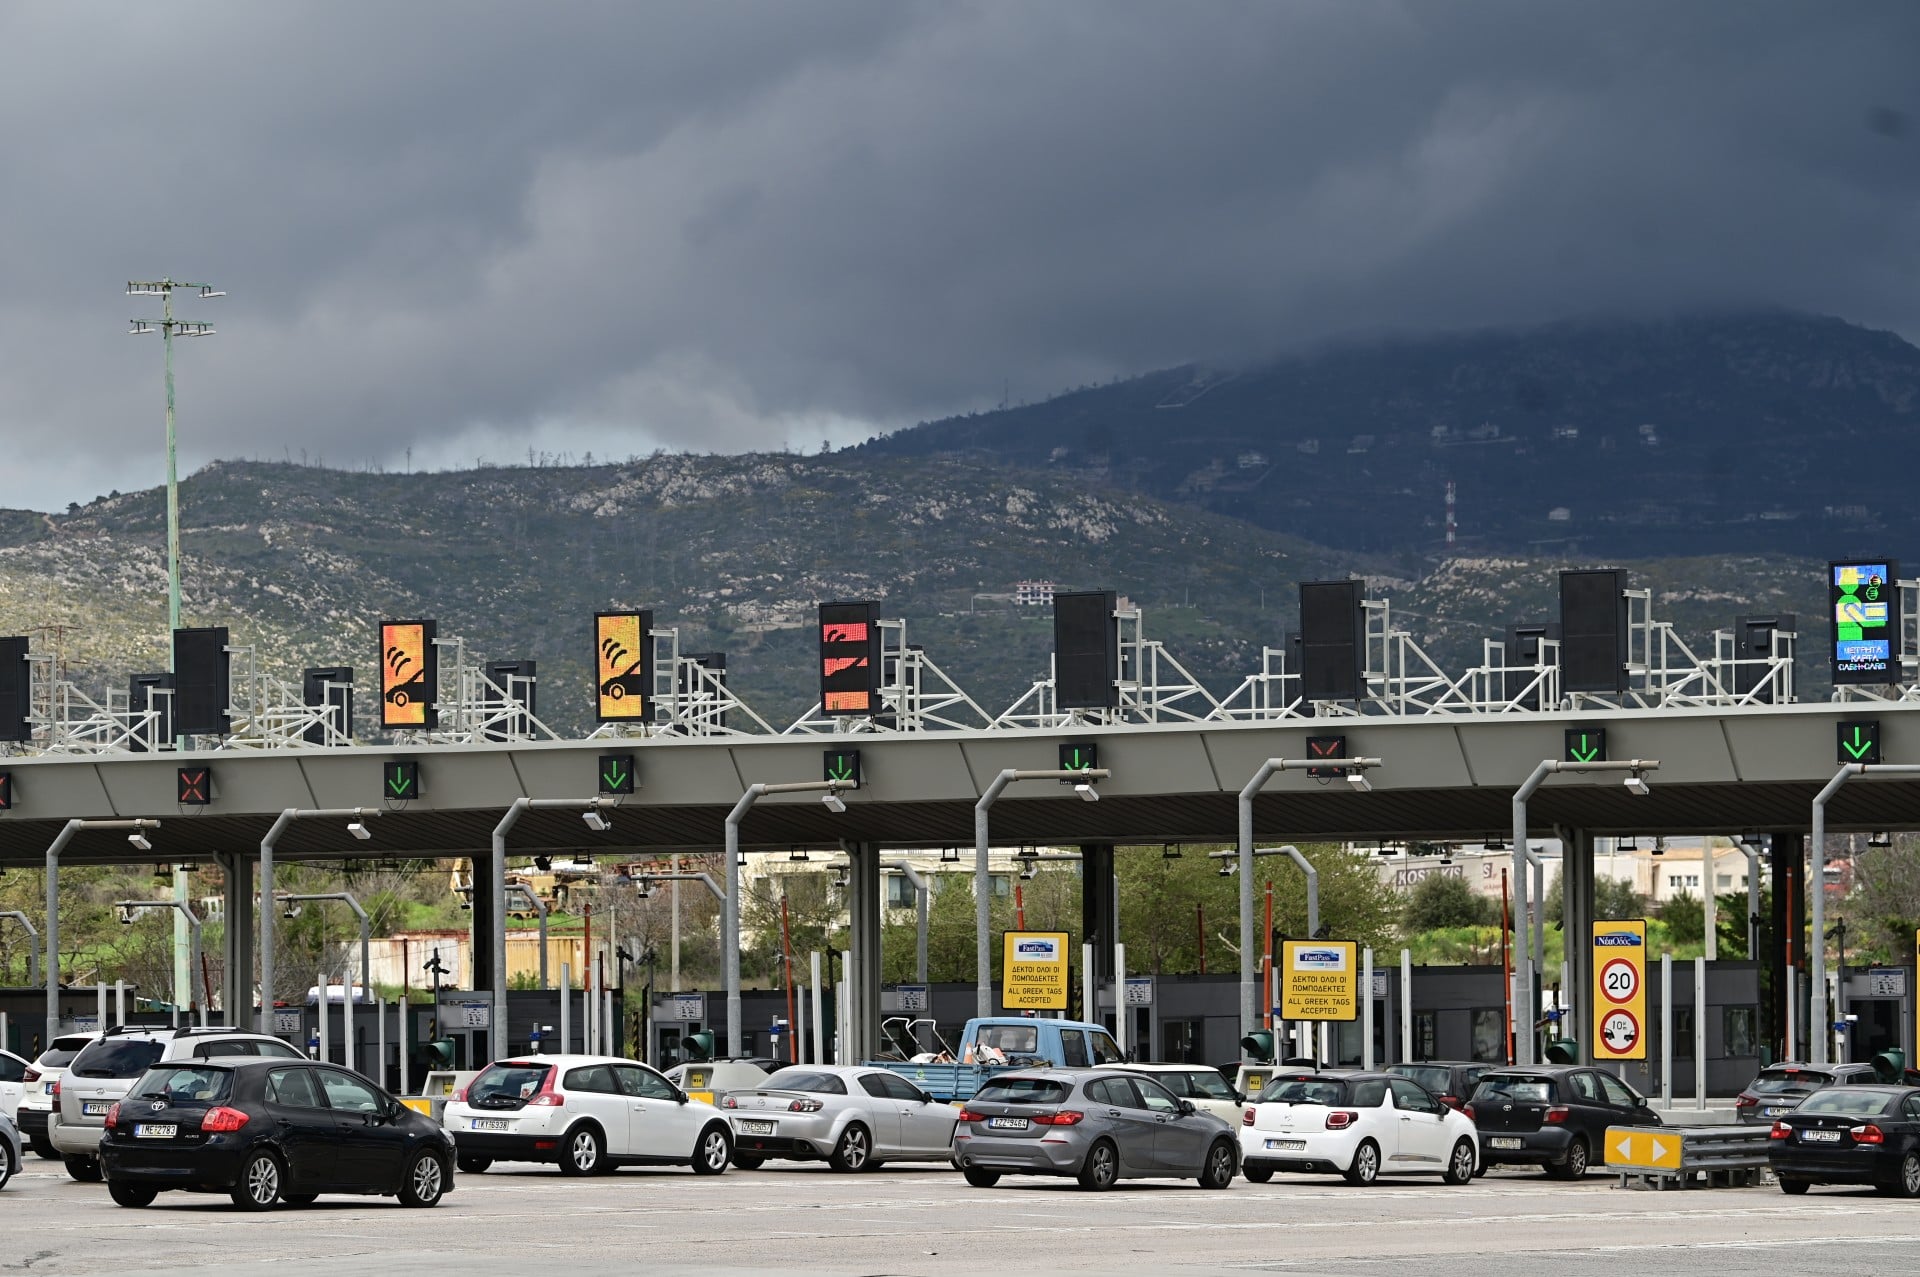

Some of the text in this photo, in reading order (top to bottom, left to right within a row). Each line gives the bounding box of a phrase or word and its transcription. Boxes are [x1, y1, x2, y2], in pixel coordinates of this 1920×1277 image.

[1012, 974, 1059, 982] ΠΟΜΠΟΔΕΚΤΕΣ
[1608, 972, 1630, 990] 20
[1008, 987, 1062, 995] ALL GREEK TAGS
[1292, 984, 1346, 993] ΠΟΜΠΟΔΕΚΤΕΣ
[1018, 996, 1051, 1004] ACCEPTED
[1332, 998, 1350, 1006] TAGS
[1300, 1007, 1338, 1015] ACCEPTED
